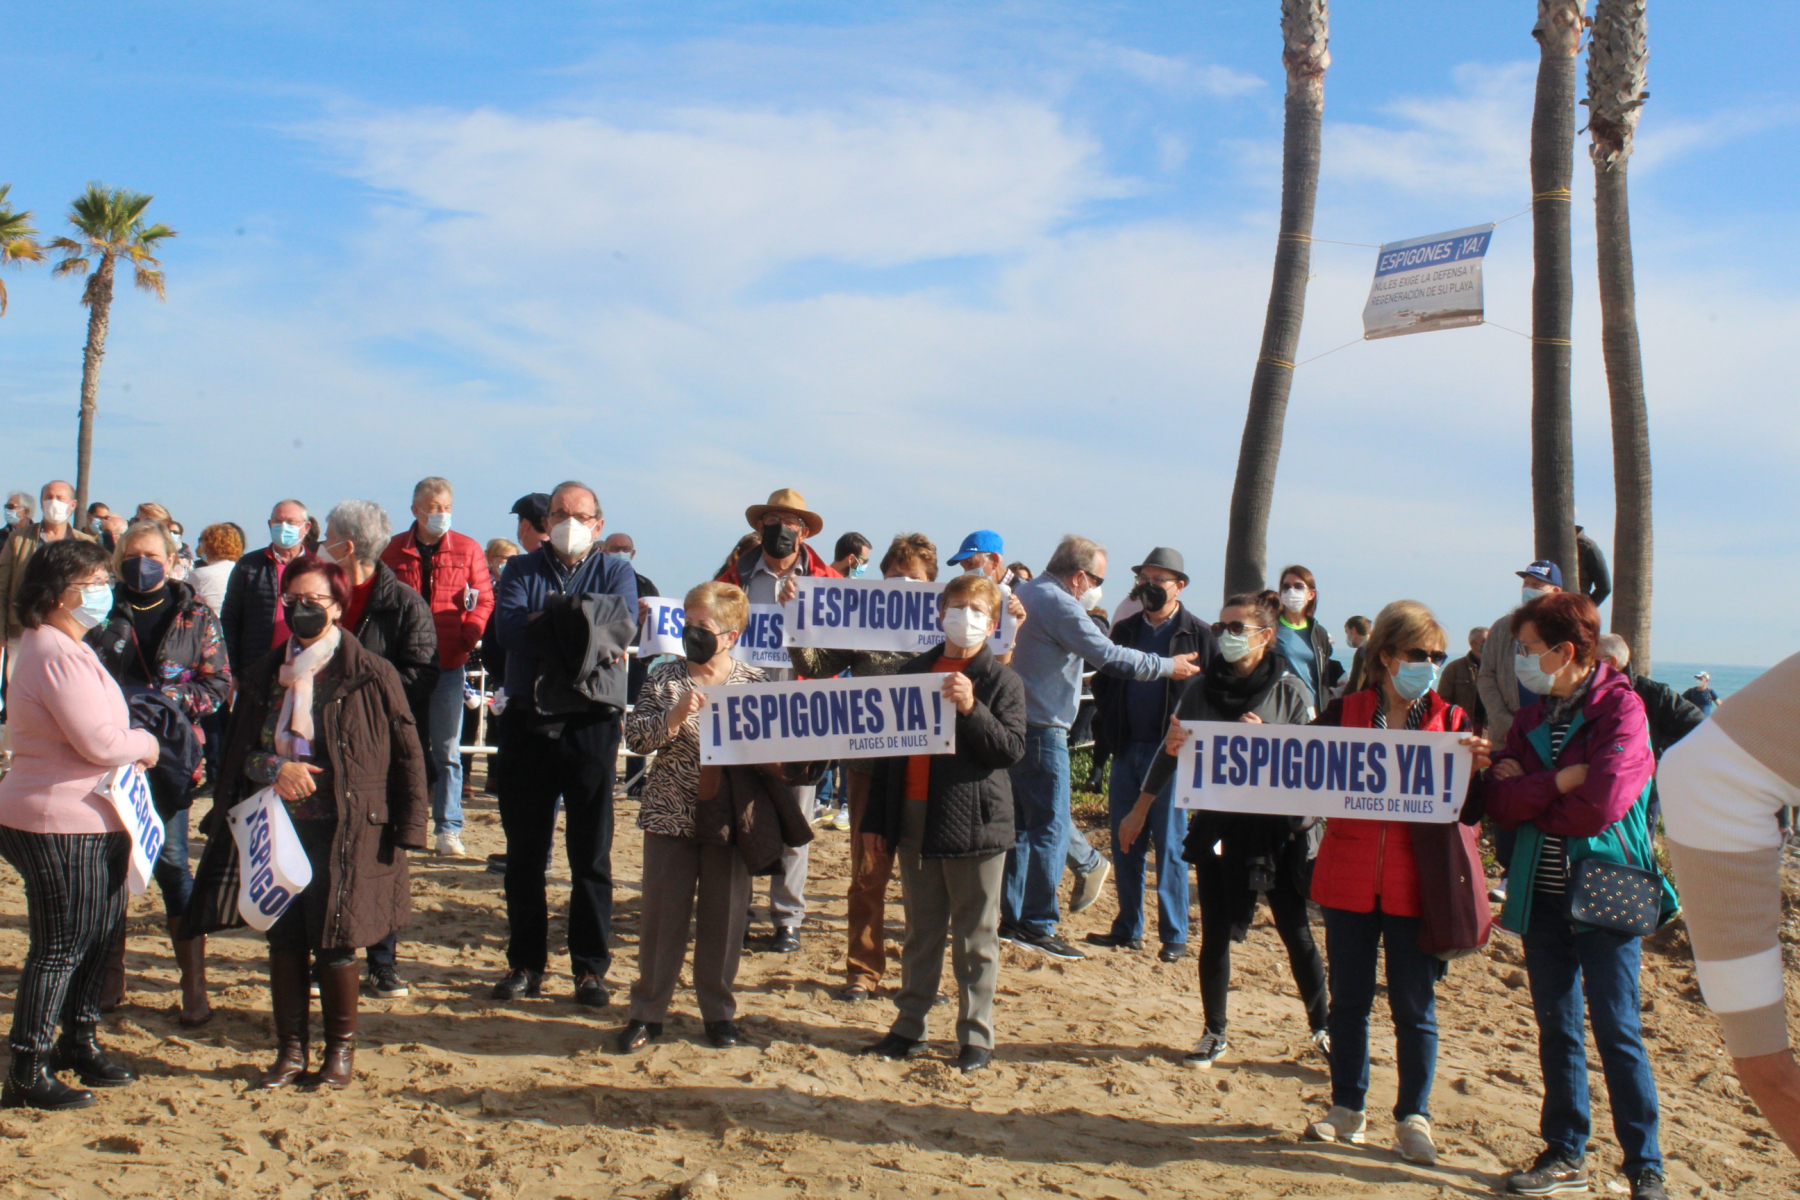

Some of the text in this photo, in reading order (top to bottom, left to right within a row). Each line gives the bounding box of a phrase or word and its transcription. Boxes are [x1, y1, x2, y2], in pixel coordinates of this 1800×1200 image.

[1380, 236, 1485, 271] ESPIGONES ¡YA!
[1374, 264, 1476, 291] NULES EXIGE LA DEFENSA Y
[1370, 280, 1474, 306] REGENERACIÓN DE SU PLAYA
[752, 651, 781, 662] PLATGES
[849, 735, 928, 750] PLATGES DE NULES
[1344, 796, 1433, 814] PLATGES DE NULES
